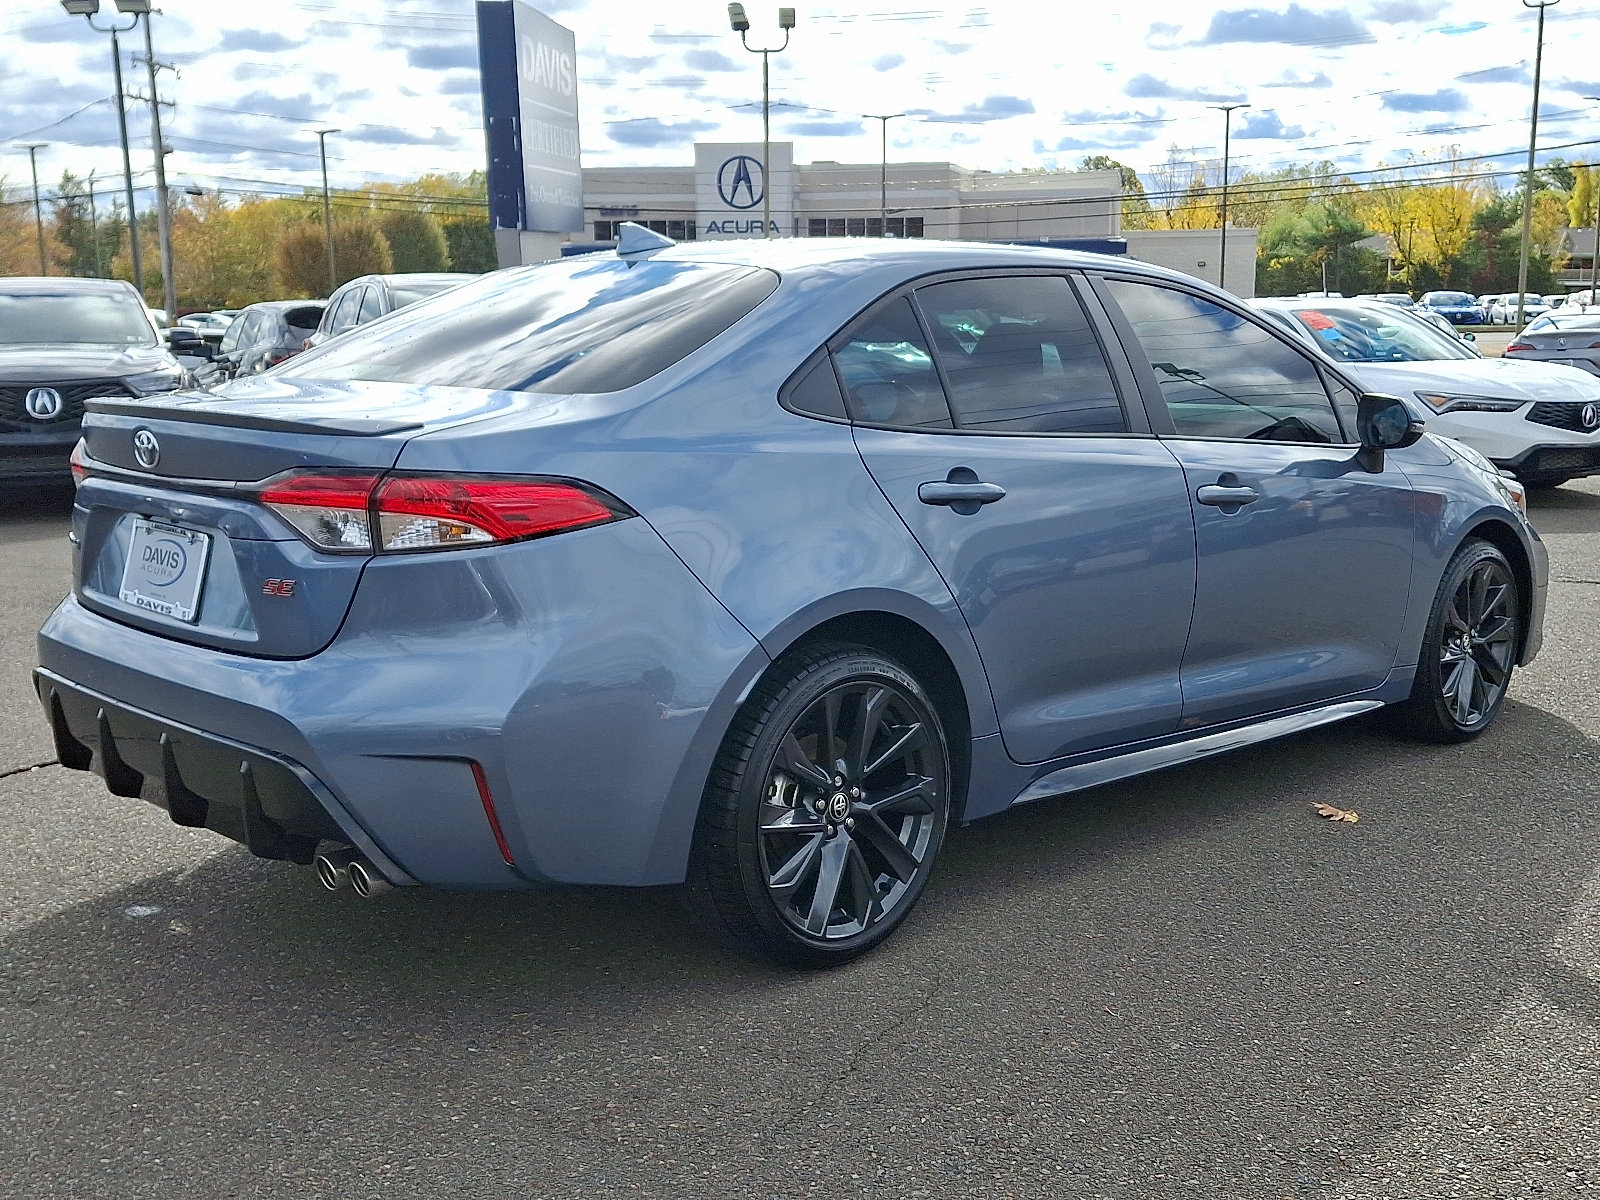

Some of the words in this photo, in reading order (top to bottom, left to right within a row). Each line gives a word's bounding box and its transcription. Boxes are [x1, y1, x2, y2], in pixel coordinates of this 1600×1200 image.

[521, 36, 572, 96] DAVIS
[523, 117, 577, 159] CERTIFIED
[705, 220, 780, 233] ACURA
[142, 545, 180, 569] DAVIS
[140, 565, 173, 578] ACURA
[263, 578, 296, 597] SE
[136, 597, 172, 615] DAVIS
